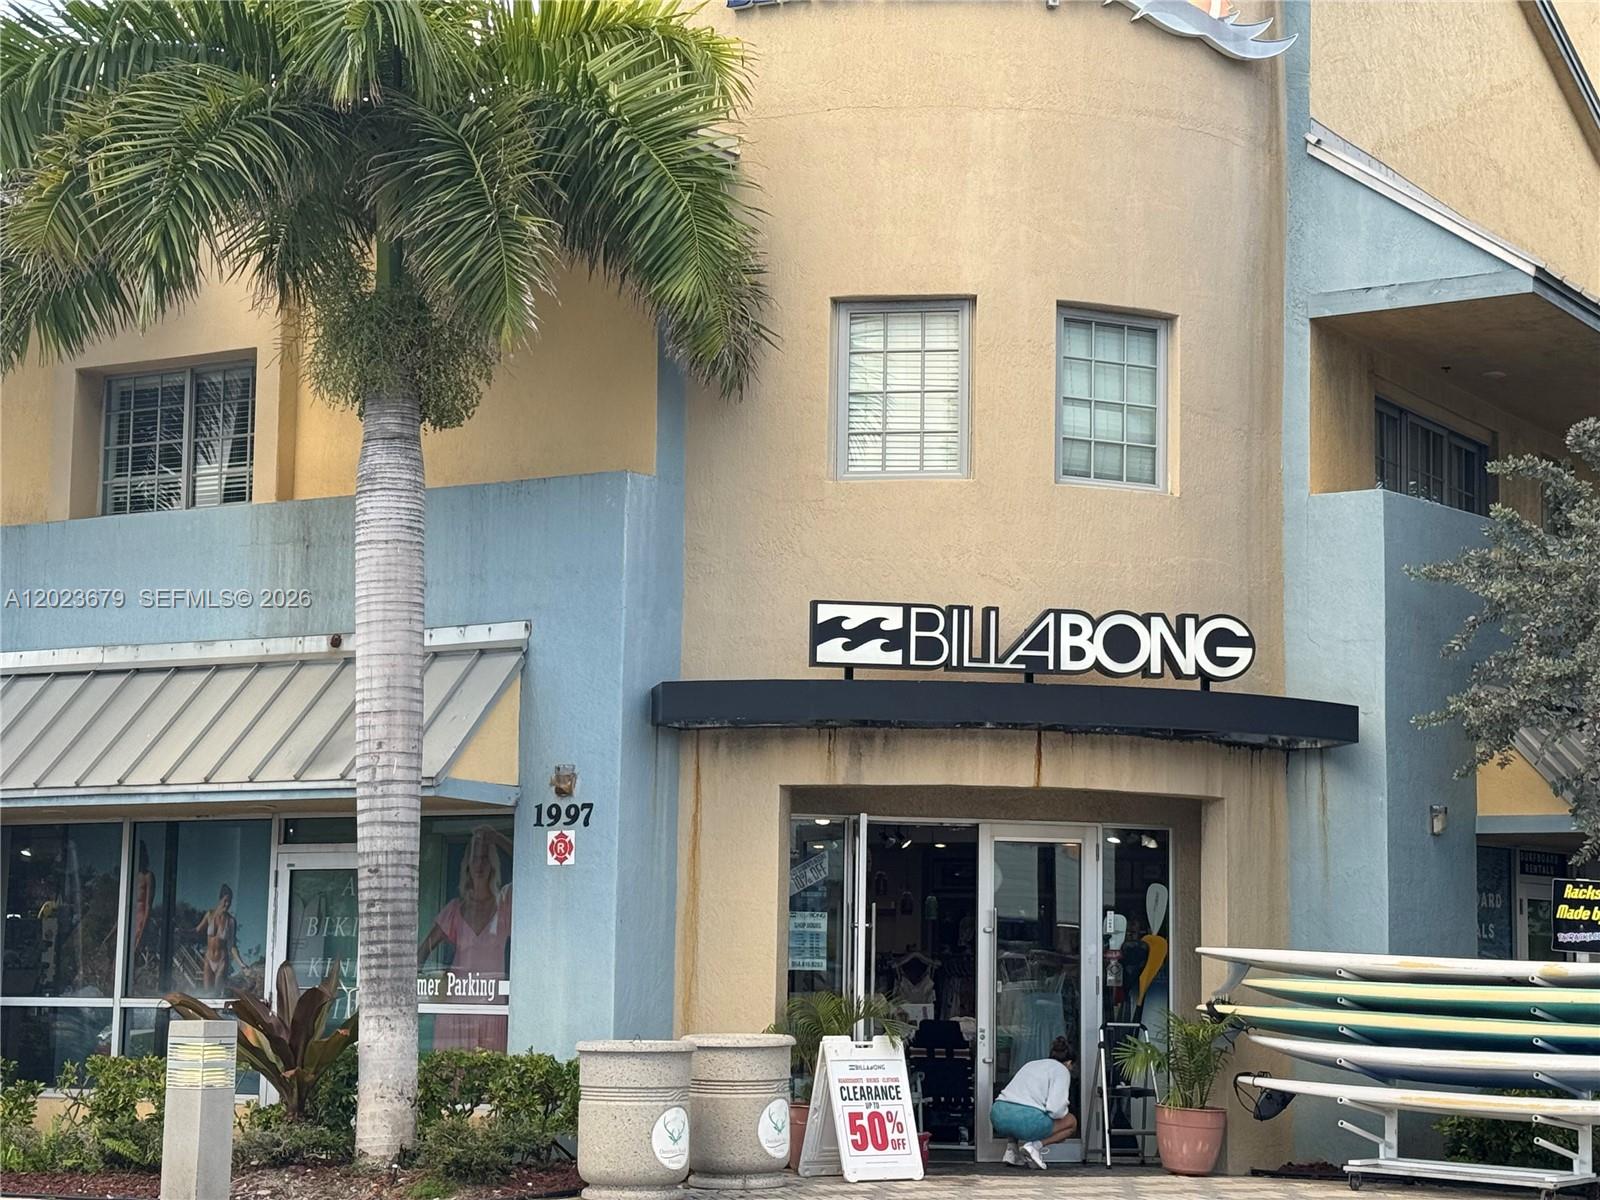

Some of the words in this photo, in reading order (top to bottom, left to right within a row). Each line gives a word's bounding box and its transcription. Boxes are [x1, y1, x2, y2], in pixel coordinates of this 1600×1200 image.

[907, 604, 1256, 682] BILLABONG
[533, 802, 594, 828] 1997
[557, 842, 565, 855] R
[342, 877, 356, 897] A
[1563, 883, 1600, 901] Racks
[1556, 904, 1591, 921] Made
[446, 971, 497, 1001] Parking
[840, 1084, 902, 1101] CLEARANCE
[865, 1102, 873, 1110] UP
[873, 1102, 880, 1110] TO
[848, 1110, 904, 1152] 50%
[890, 1138, 906, 1151] OFF
